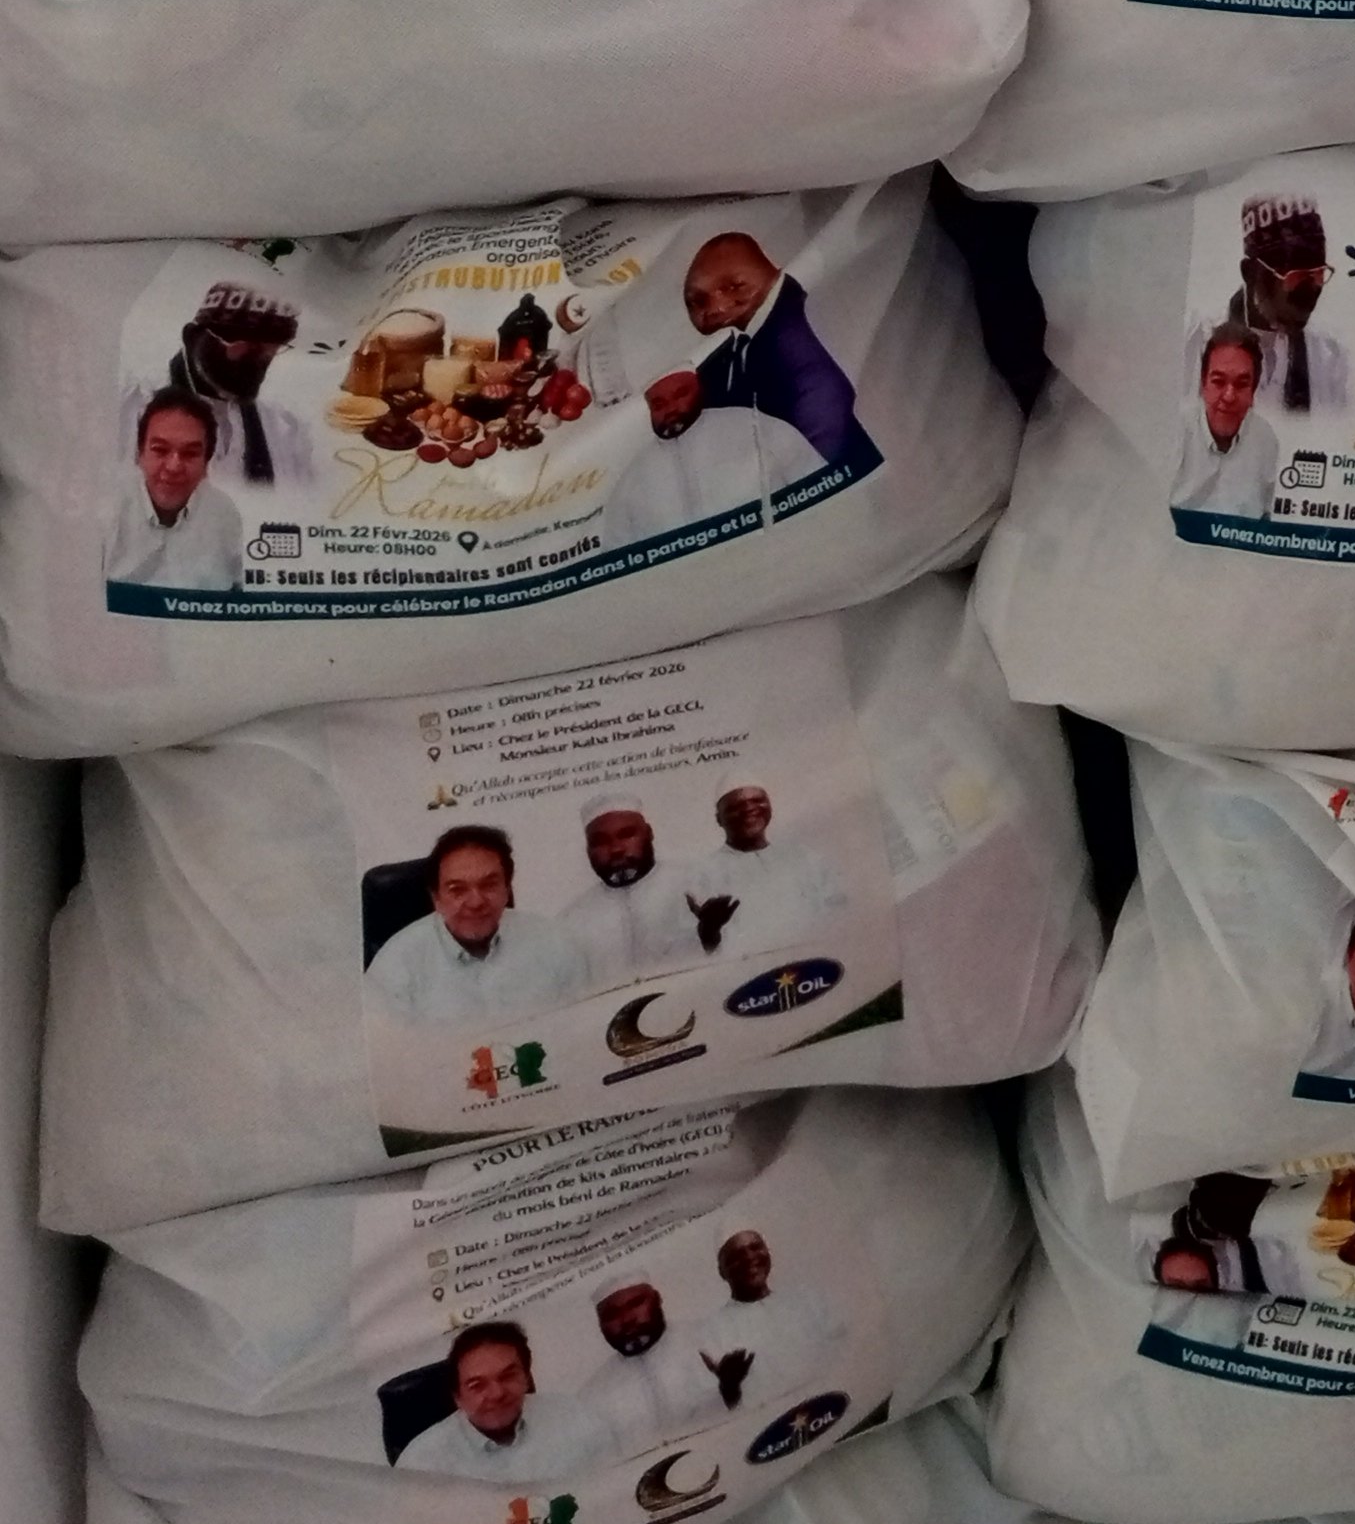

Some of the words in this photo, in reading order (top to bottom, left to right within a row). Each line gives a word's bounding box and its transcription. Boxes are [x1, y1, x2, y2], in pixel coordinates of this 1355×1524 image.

[1315, 0, 1355, 15] pour
[363, 568, 489, 586] récipiendaires
[538, 536, 600, 568] conviés
[647, 528, 718, 563] partage
[499, 683, 572, 708] Dimanche
[577, 679, 594, 692] 22
[599, 669, 645, 686] février
[648, 662, 686, 677] 2026
[498, 731, 534, 746] Chez
[536, 729, 550, 740] le
[553, 714, 622, 736] Président
[627, 710, 646, 724] de
[647, 706, 661, 720] la
[500, 741, 568, 763] Monsieur
[572, 733, 609, 750] Kaba
[612, 722, 676, 743] Ibrahima
[737, 992, 778, 1013] star
[516, 1201, 555, 1216] mois
[558, 1188, 593, 1207] béni
[597, 1184, 616, 1198] de
